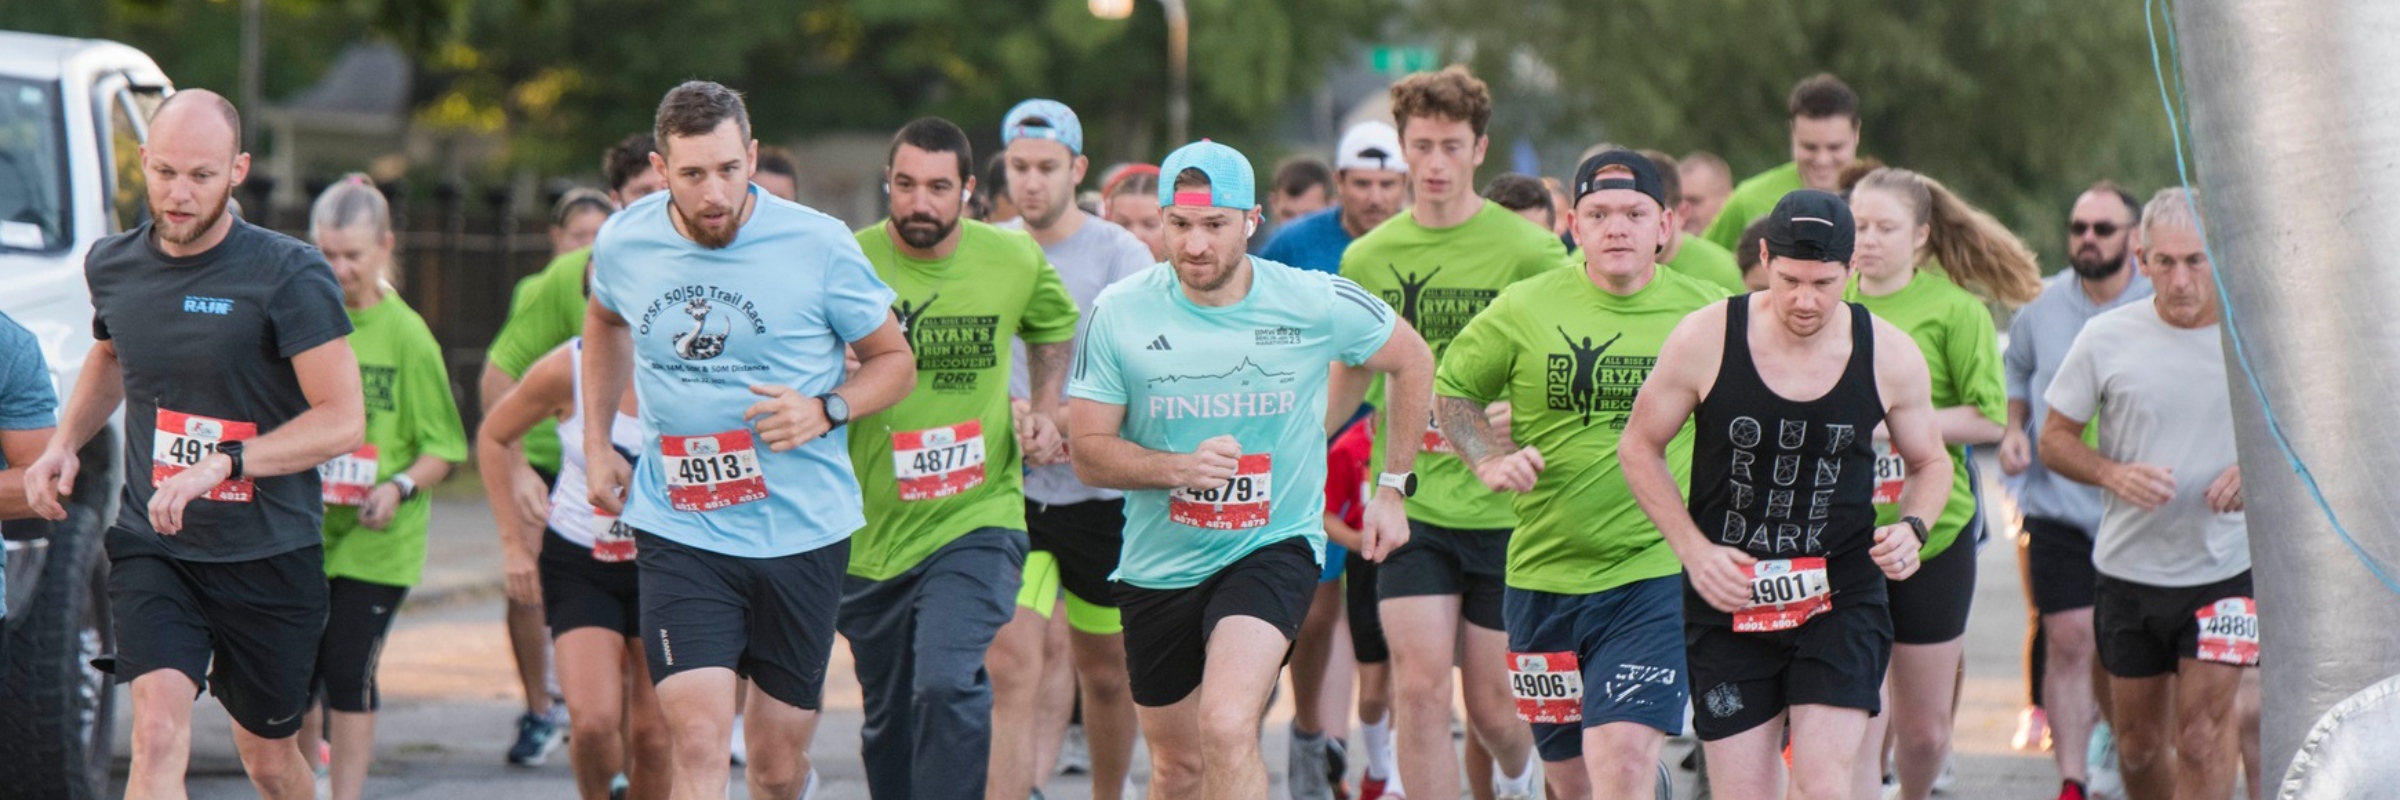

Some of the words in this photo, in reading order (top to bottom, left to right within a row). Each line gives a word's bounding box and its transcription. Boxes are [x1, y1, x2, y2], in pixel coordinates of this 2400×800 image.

[640, 298, 663, 335] OPSF
[709, 285, 743, 306] Trail
[742, 301, 767, 335] Race
[921, 328, 991, 342] RYAN'S
[924, 346, 951, 355] RUN
[955, 346, 980, 355] FOR
[922, 358, 994, 368] RECOVERY
[1548, 356, 1569, 408] 2025
[1601, 369, 1652, 383] RYA
[1602, 388, 1633, 396] RUN
[1149, 389, 1297, 420] FINISHER
[169, 437, 215, 466] 491
[913, 442, 969, 474] 4877
[679, 453, 742, 484] 4913
[1731, 448, 1842, 488] RUN
[704, 499, 731, 509] 4913
[739, 491, 766, 502] 4913
[1173, 514, 1199, 526] 4879
[1206, 520, 1233, 529] 4879
[1240, 517, 1266, 528] 4879
[1722, 509, 1828, 554] DARK
[1738, 621, 1764, 631] 4901
[1772, 617, 1799, 627] 4901
[2206, 615, 2256, 638] 4880
[1513, 673, 1566, 698] 4906
